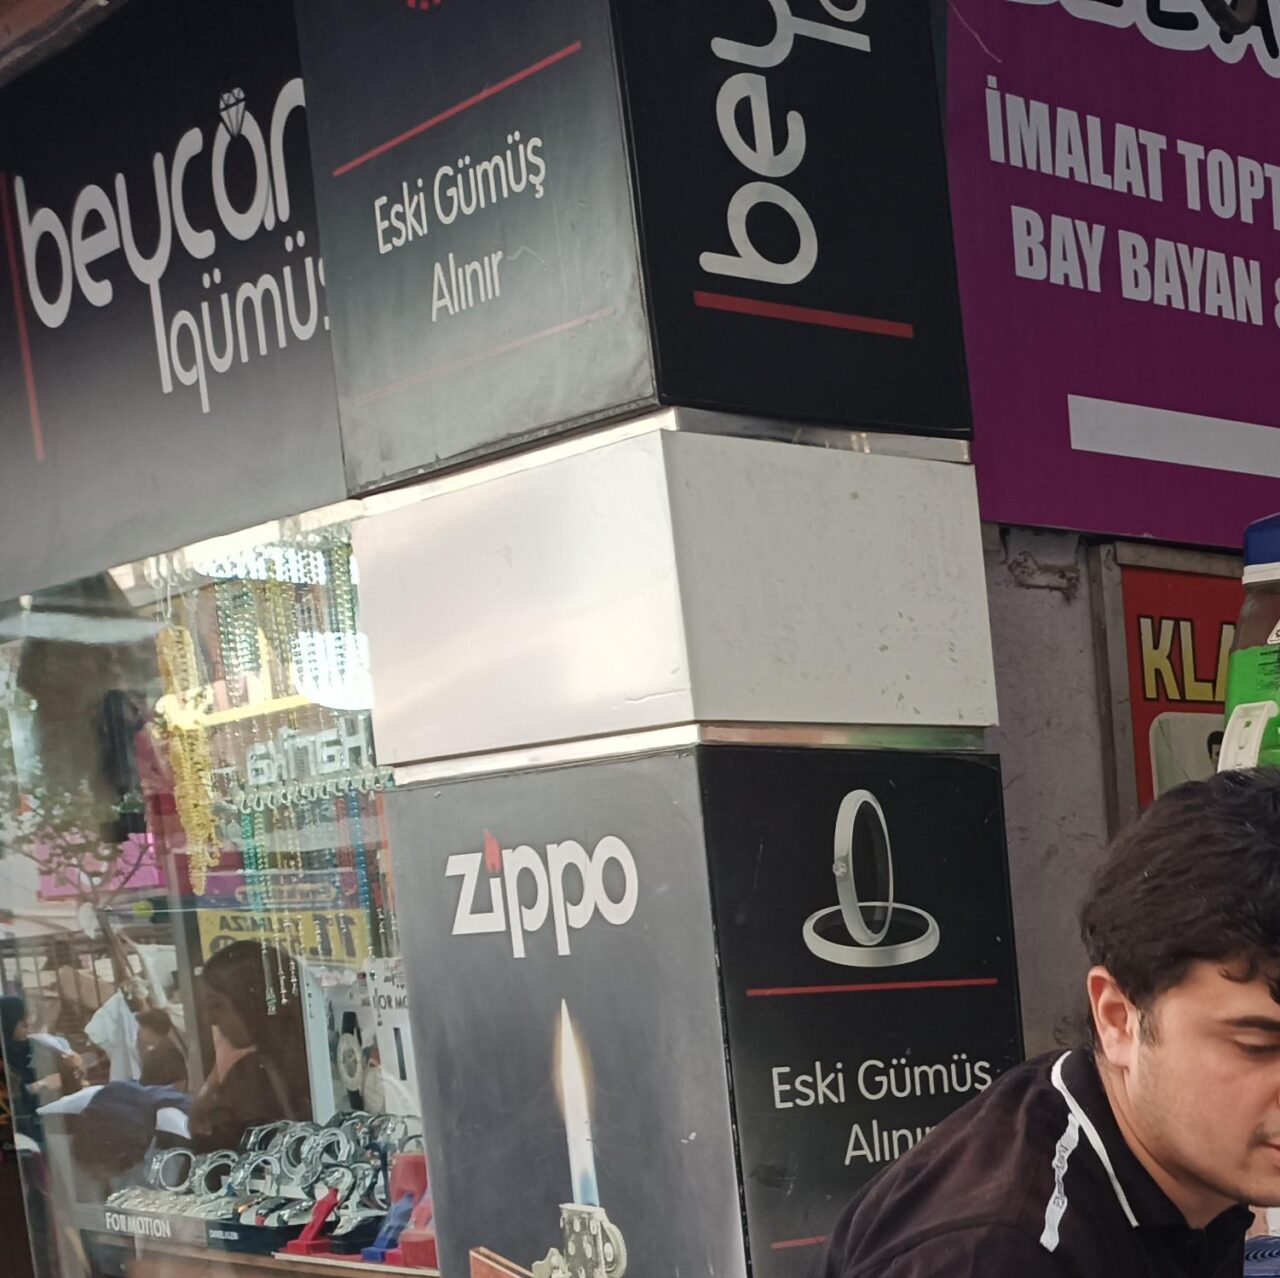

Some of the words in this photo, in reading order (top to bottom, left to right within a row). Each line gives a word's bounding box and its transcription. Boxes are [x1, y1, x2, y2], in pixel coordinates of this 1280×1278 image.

[374, 178, 428, 255] Eski
[434, 131, 547, 226] Gümüş
[699, 0, 872, 285] bey
[985, 75, 1167, 202] İMALAT
[431, 250, 503, 321] Alınır
[1011, 205, 1106, 293] BAY
[1118, 228, 1264, 326] BAYAN
[772, 1061, 846, 1109] Eski
